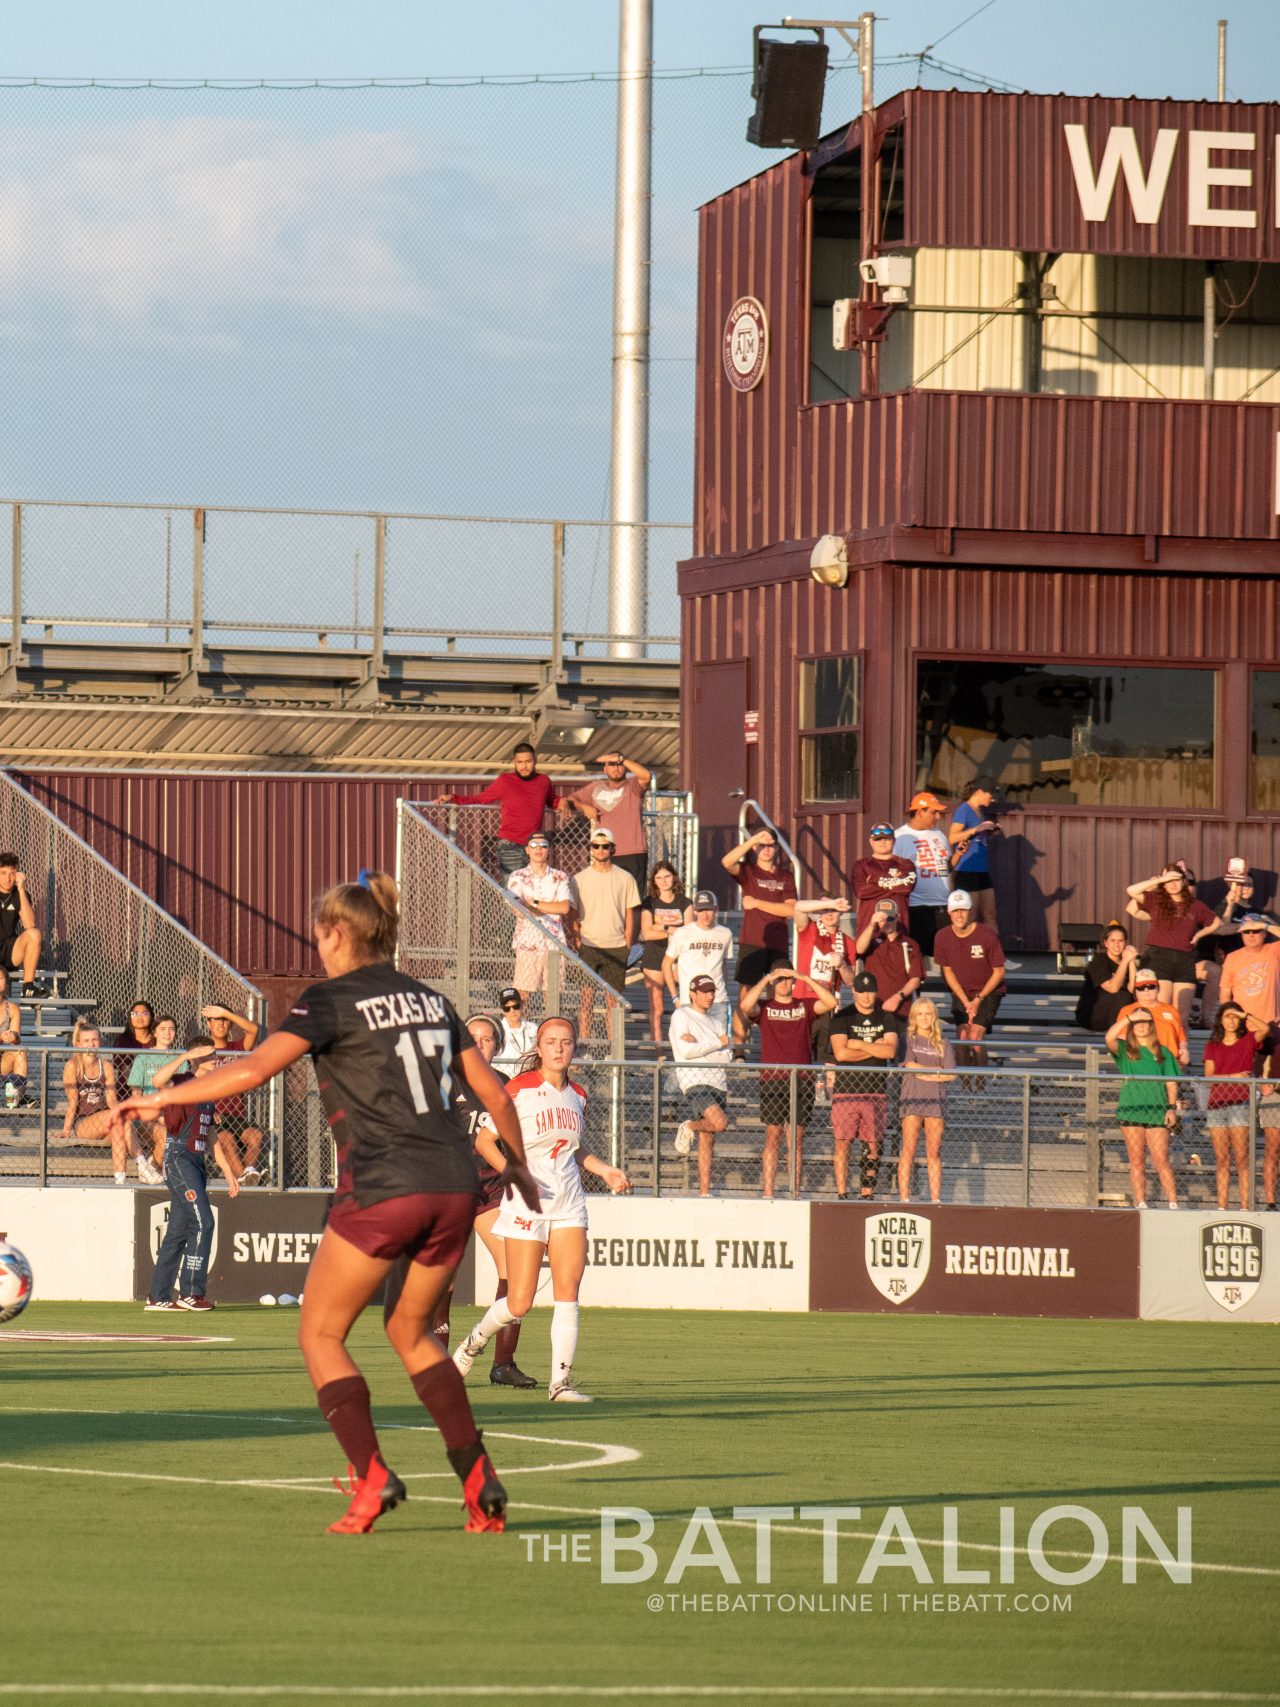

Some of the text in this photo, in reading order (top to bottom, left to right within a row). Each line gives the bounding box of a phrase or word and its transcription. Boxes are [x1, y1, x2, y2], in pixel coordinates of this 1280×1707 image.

[1064, 124, 1280, 228] WE
[689, 942, 724, 951] AGGIES
[355, 991, 424, 1031] TEXAS
[766, 1007, 792, 1019] TEXAS
[394, 1029, 451, 1114] 17
[536, 1108, 554, 1135] SAM
[550, 1138, 568, 1159] 7
[878, 1218, 918, 1235] NCAA
[1212, 1225, 1253, 1244] NCAA
[715, 1240, 793, 1269] FINAL
[871, 1237, 924, 1268] 1997
[945, 1245, 1075, 1277] REGIONAL
[1205, 1245, 1259, 1277] 1996
